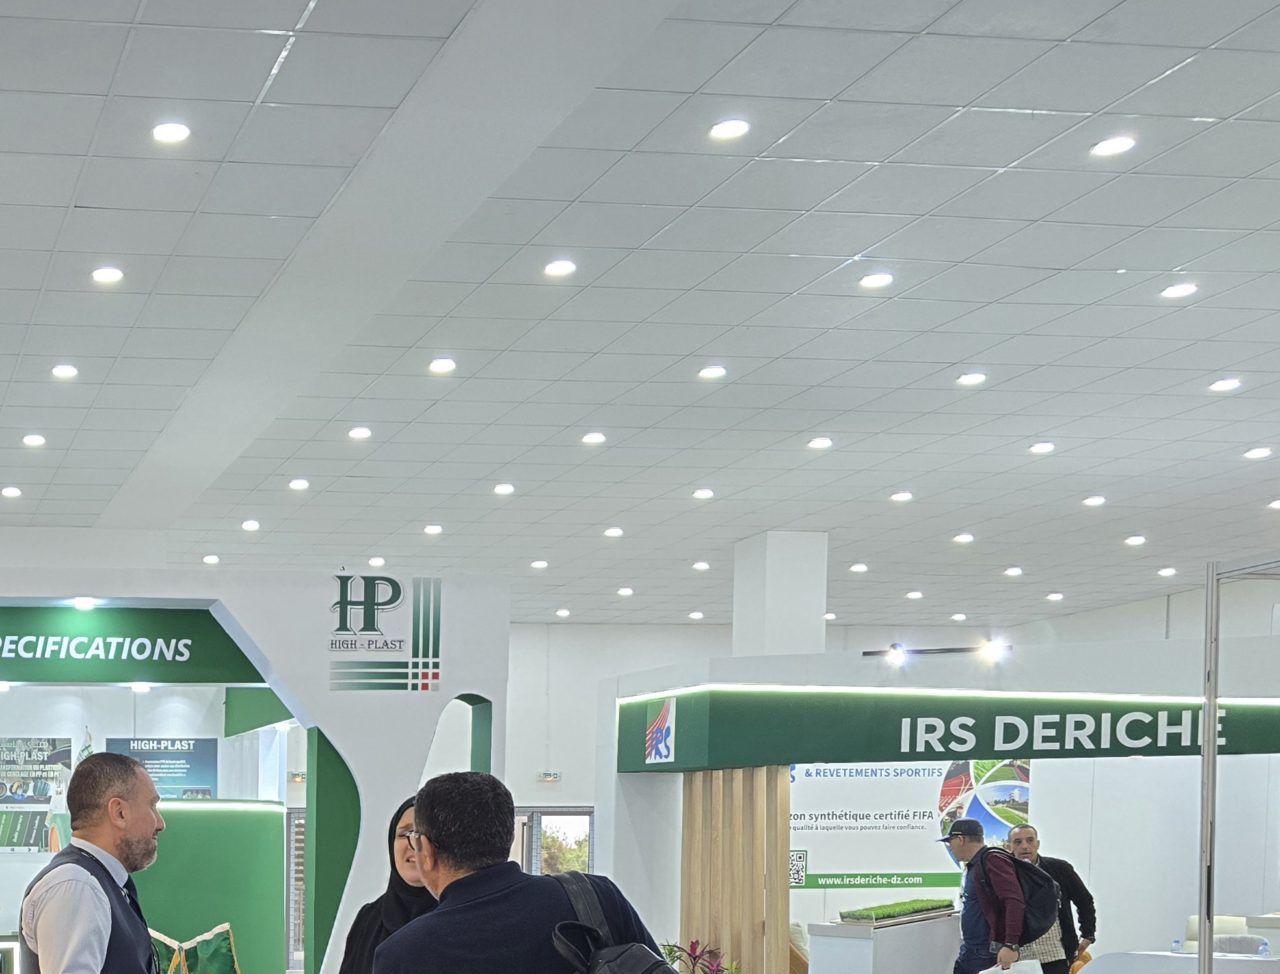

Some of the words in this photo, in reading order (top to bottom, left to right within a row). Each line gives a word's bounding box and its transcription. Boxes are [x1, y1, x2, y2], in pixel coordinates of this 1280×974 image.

[330, 575, 403, 635] HP
[900, 716, 977, 753] IRS
[994, 708, 1227, 751] DERICHE
[130, 740, 195, 750] HIGH-PLAST
[804, 768, 813, 778] &
[815, 768, 891, 778] REVETEMENTS
[893, 767, 943, 778] SPORTIFS
[809, 809, 871, 823] synthétique
[873, 809, 910, 820] certifié
[912, 810, 934, 821] FIFA
[818, 875, 923, 885] www.irsderiche-dz.com
